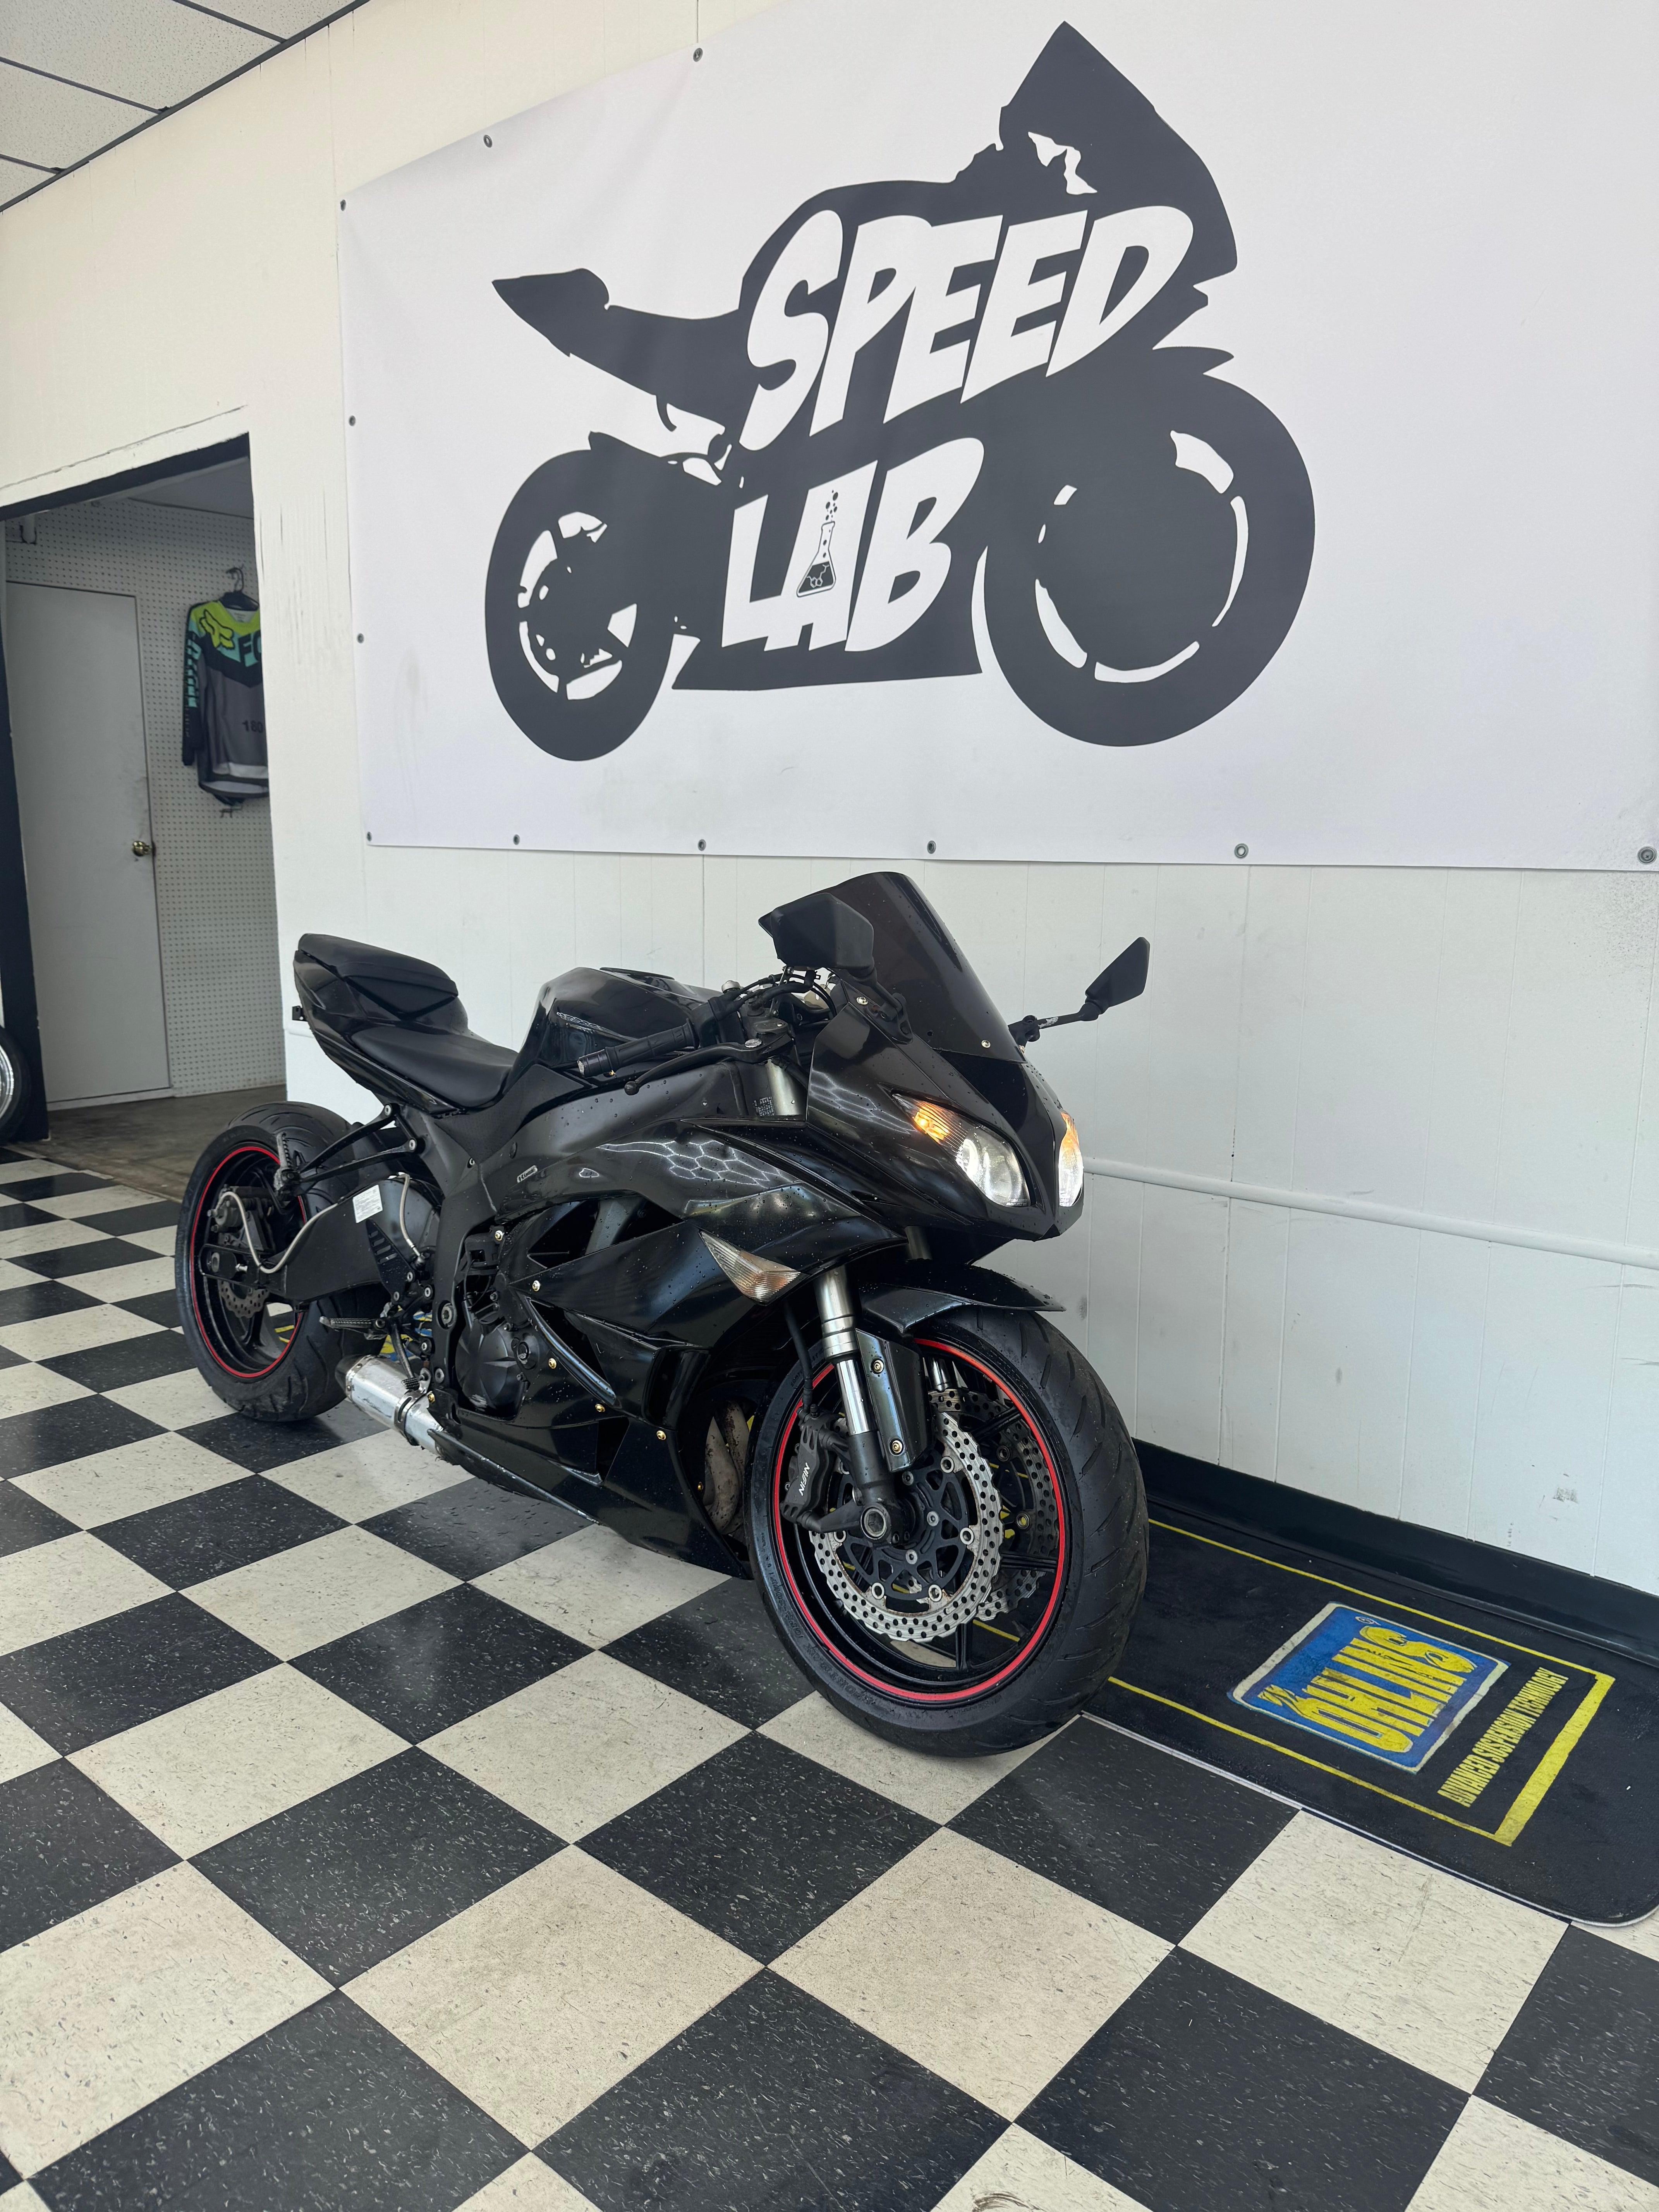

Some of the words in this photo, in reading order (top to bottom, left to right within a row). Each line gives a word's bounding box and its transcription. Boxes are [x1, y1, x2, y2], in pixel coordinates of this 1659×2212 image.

[739, 205, 1194, 451] SPEED
[721, 437, 985, 652] LAB
[237, 630, 262, 667] FO
[1437, 1754, 1500, 1807] ADVANCED
[1472, 1708, 1536, 1762] SUSPENSION
[1507, 1667, 1569, 1717] TECHNOLOGY
